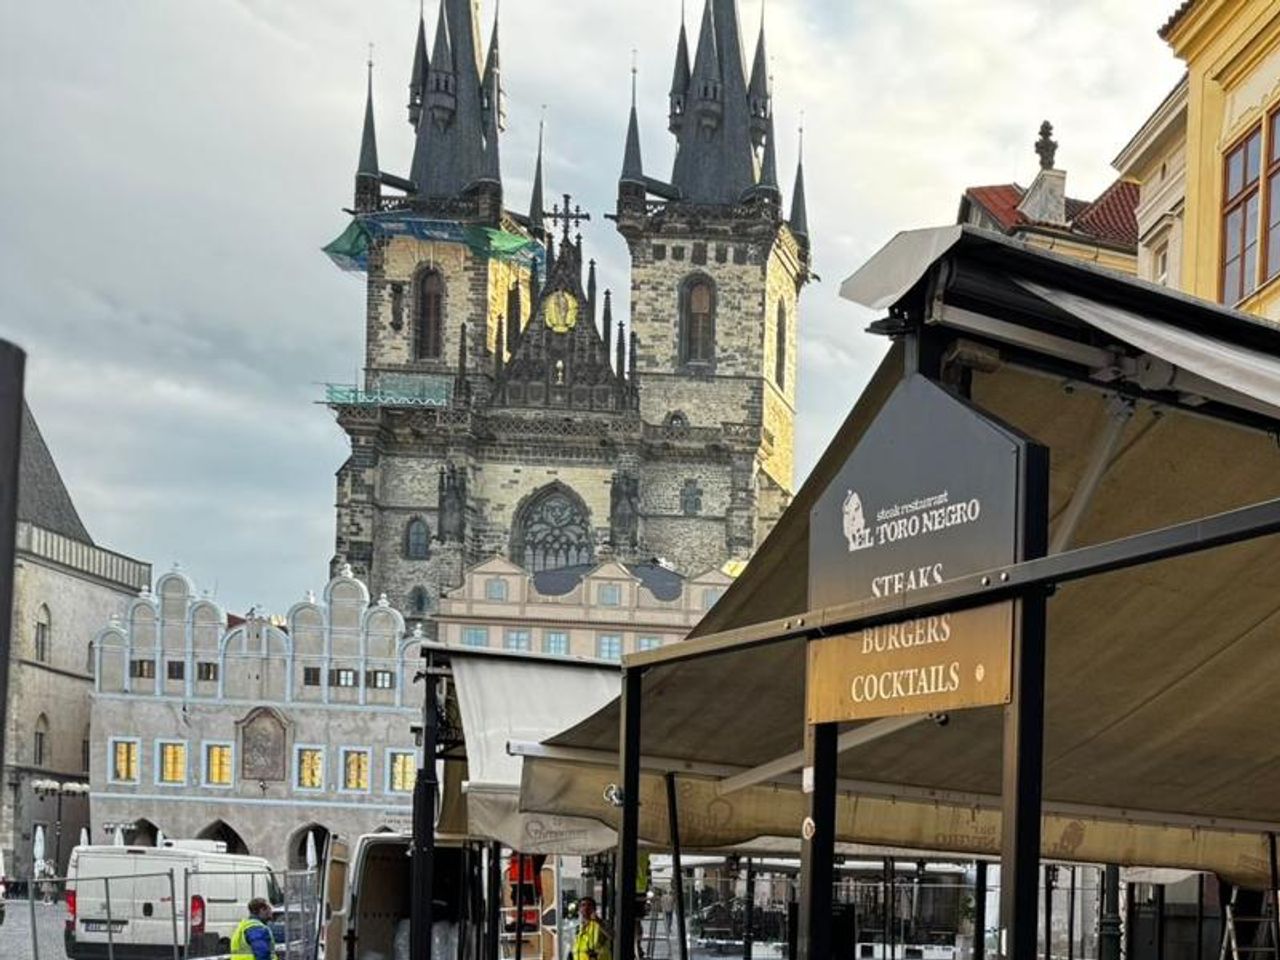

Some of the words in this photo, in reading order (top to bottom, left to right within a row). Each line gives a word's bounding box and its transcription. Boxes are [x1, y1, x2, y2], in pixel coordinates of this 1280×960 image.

[853, 527, 874, 549] EL
[876, 515, 919, 545] TORO
[921, 499, 980, 533] NEGRO
[871, 563, 943, 598] STEAKS
[862, 613, 951, 654] BURGERS
[852, 661, 960, 702] COCKTAILS
